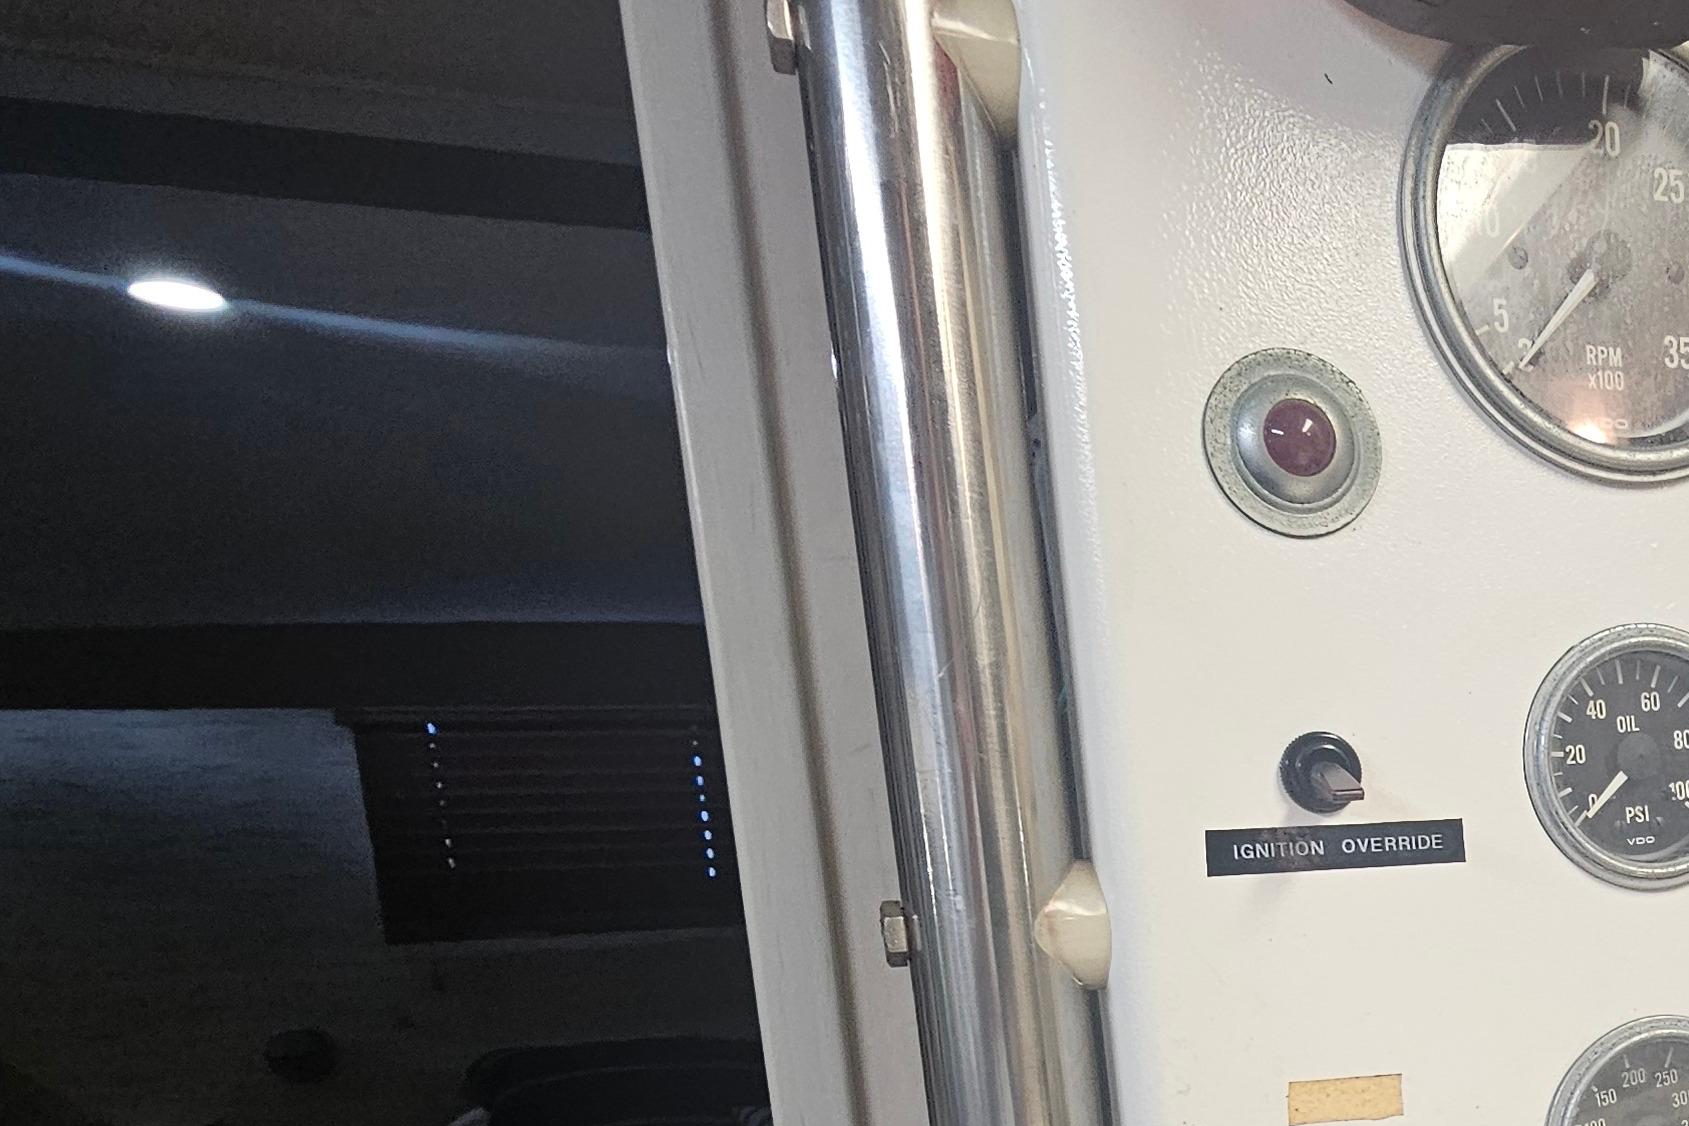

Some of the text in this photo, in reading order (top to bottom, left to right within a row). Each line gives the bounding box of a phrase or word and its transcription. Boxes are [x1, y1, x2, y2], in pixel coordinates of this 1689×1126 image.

[1588, 119, 1621, 157] 20
[1653, 167, 1685, 204] 25
[1493, 298, 1509, 333] 5
[1586, 345, 1623, 367] RPM
[1587, 371, 1624, 391] x100
[1586, 699, 1607, 720] 40
[1641, 692, 1660, 712] 60
[1616, 715, 1640, 733] OIL
[1565, 744, 1586, 765] 20
[1625, 805, 1649, 824] PSI
[1233, 834, 1443, 860] IGNITION OVERRIDE
[1626, 835, 1655, 845] VDO
[1621, 1067, 1647, 1088] 200
[1654, 1068, 1678, 1088] 250
[1595, 1088, 1617, 1108] 150
